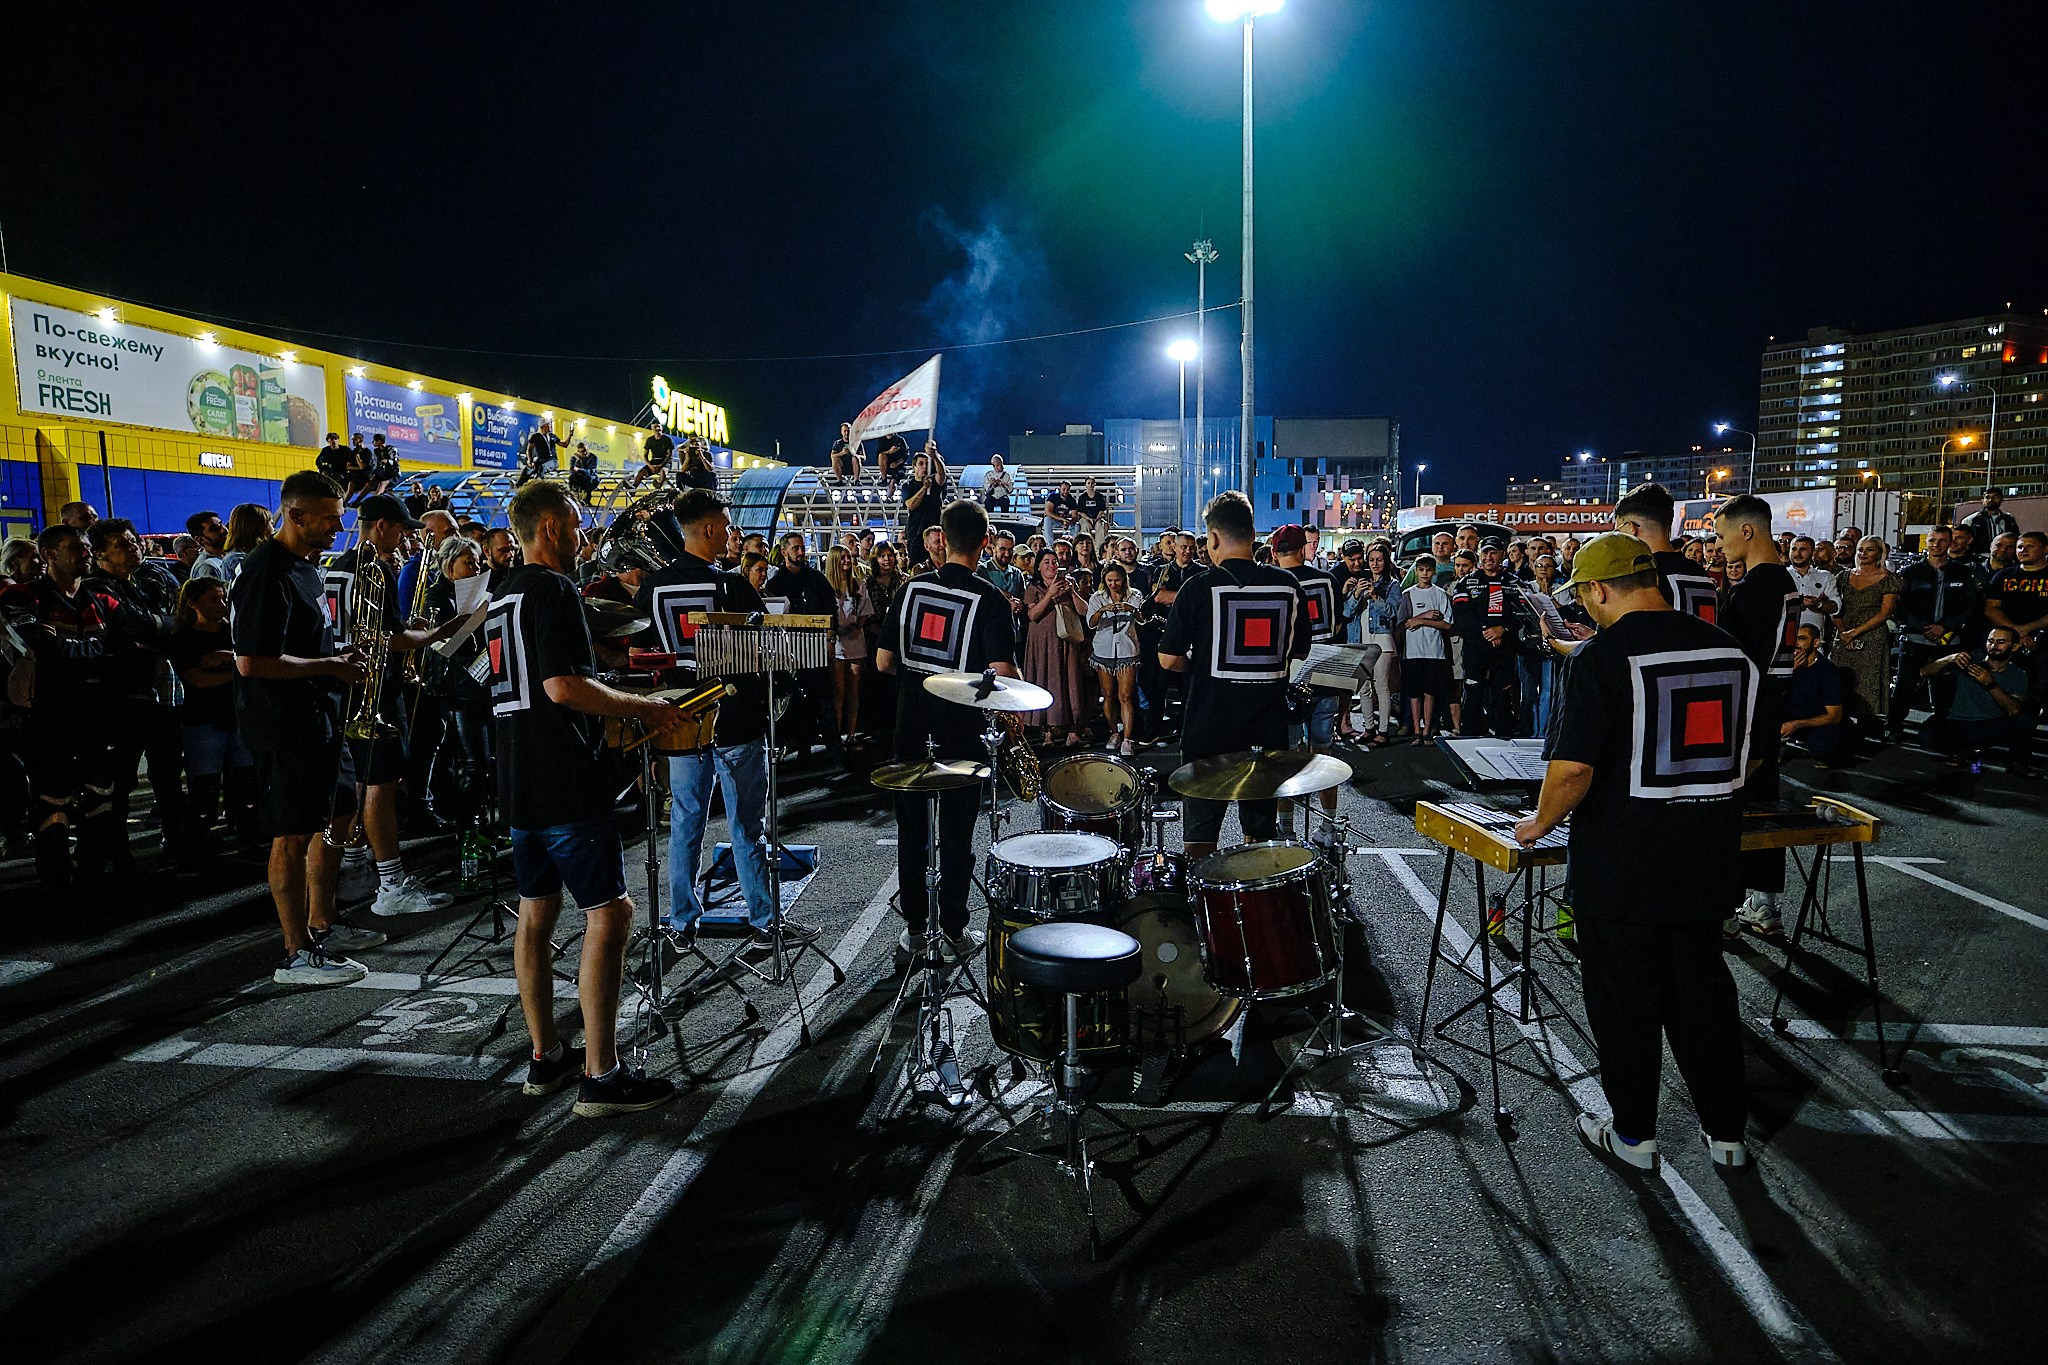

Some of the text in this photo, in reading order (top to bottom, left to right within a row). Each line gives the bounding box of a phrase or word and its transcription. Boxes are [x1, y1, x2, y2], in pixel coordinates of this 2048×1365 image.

[33, 313, 164, 362] По-свежему
[35, 344, 119, 371] вкусно!
[48, 373, 83, 387] лента
[38, 383, 112, 416] FRESH
[354, 391, 403, 411] Доставка
[355, 408, 418, 426] и самовывоз
[487, 408, 518, 425] Выбираю
[666, 390, 730, 445] ЛЕНТА
[391, 430, 400, 438] до
[400, 428, 409, 438] 75
[488, 421, 508, 439] Ленту
[1463, 509, 1616, 525] ВСЁ ДЛЯ СВАРКИ
